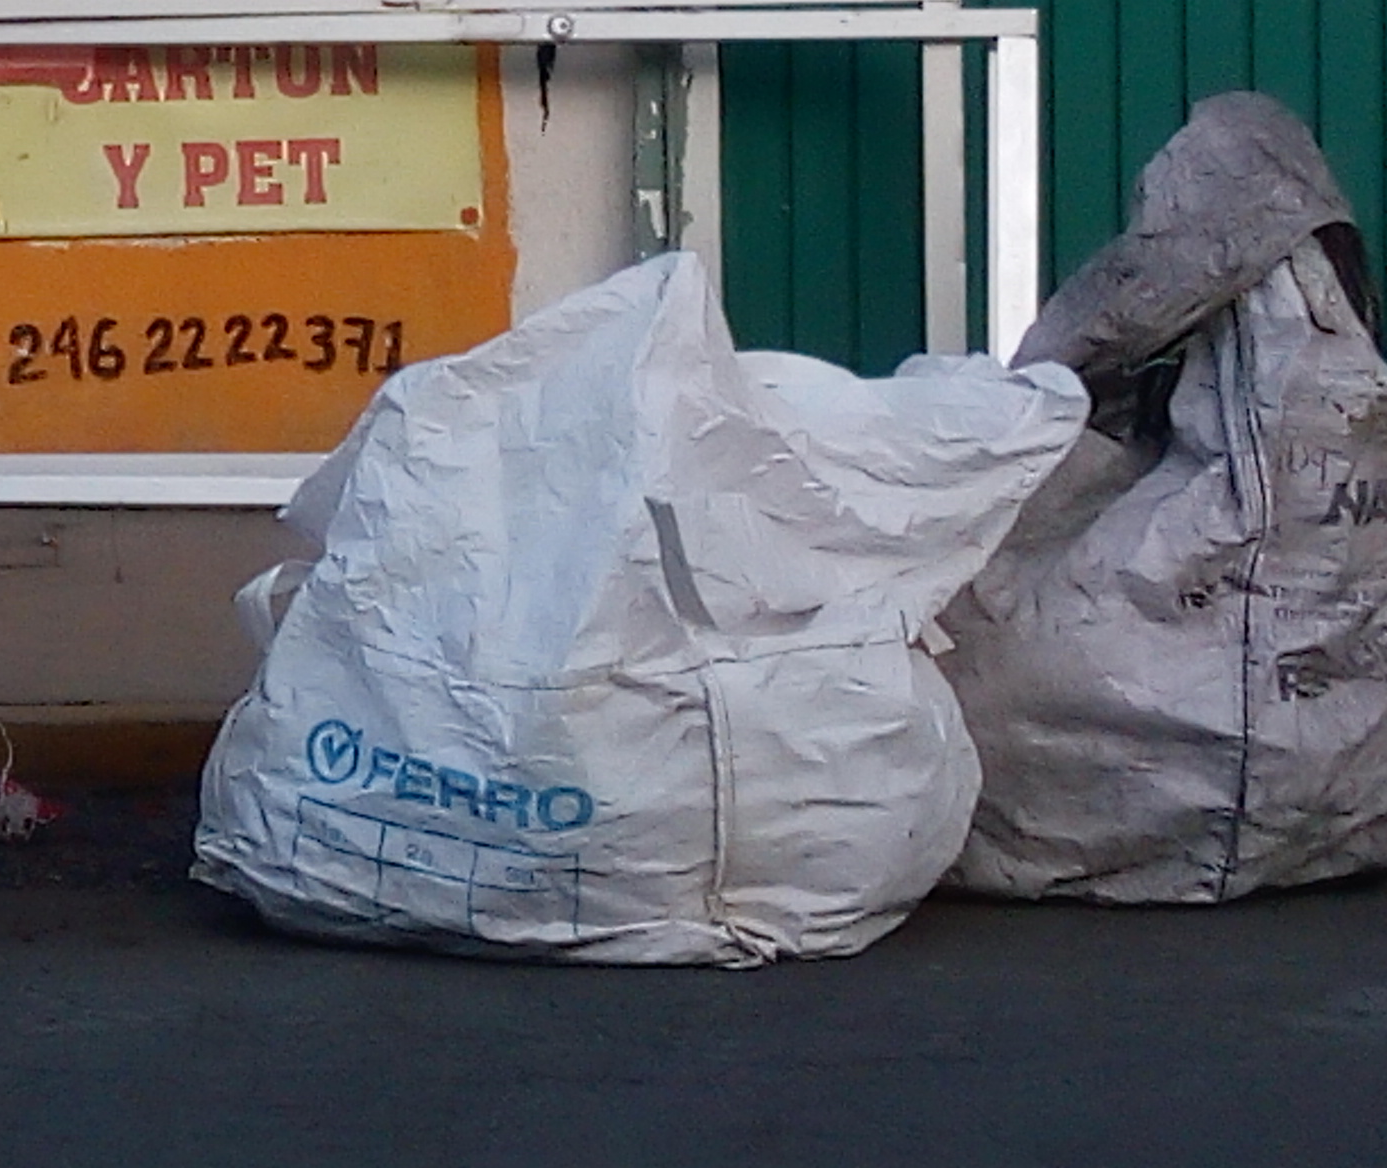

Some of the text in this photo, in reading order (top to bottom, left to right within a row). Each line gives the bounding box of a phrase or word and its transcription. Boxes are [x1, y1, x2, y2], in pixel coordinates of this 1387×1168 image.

[102, 137, 341, 209] Y PET
[361, 745, 595, 833] FERRO
